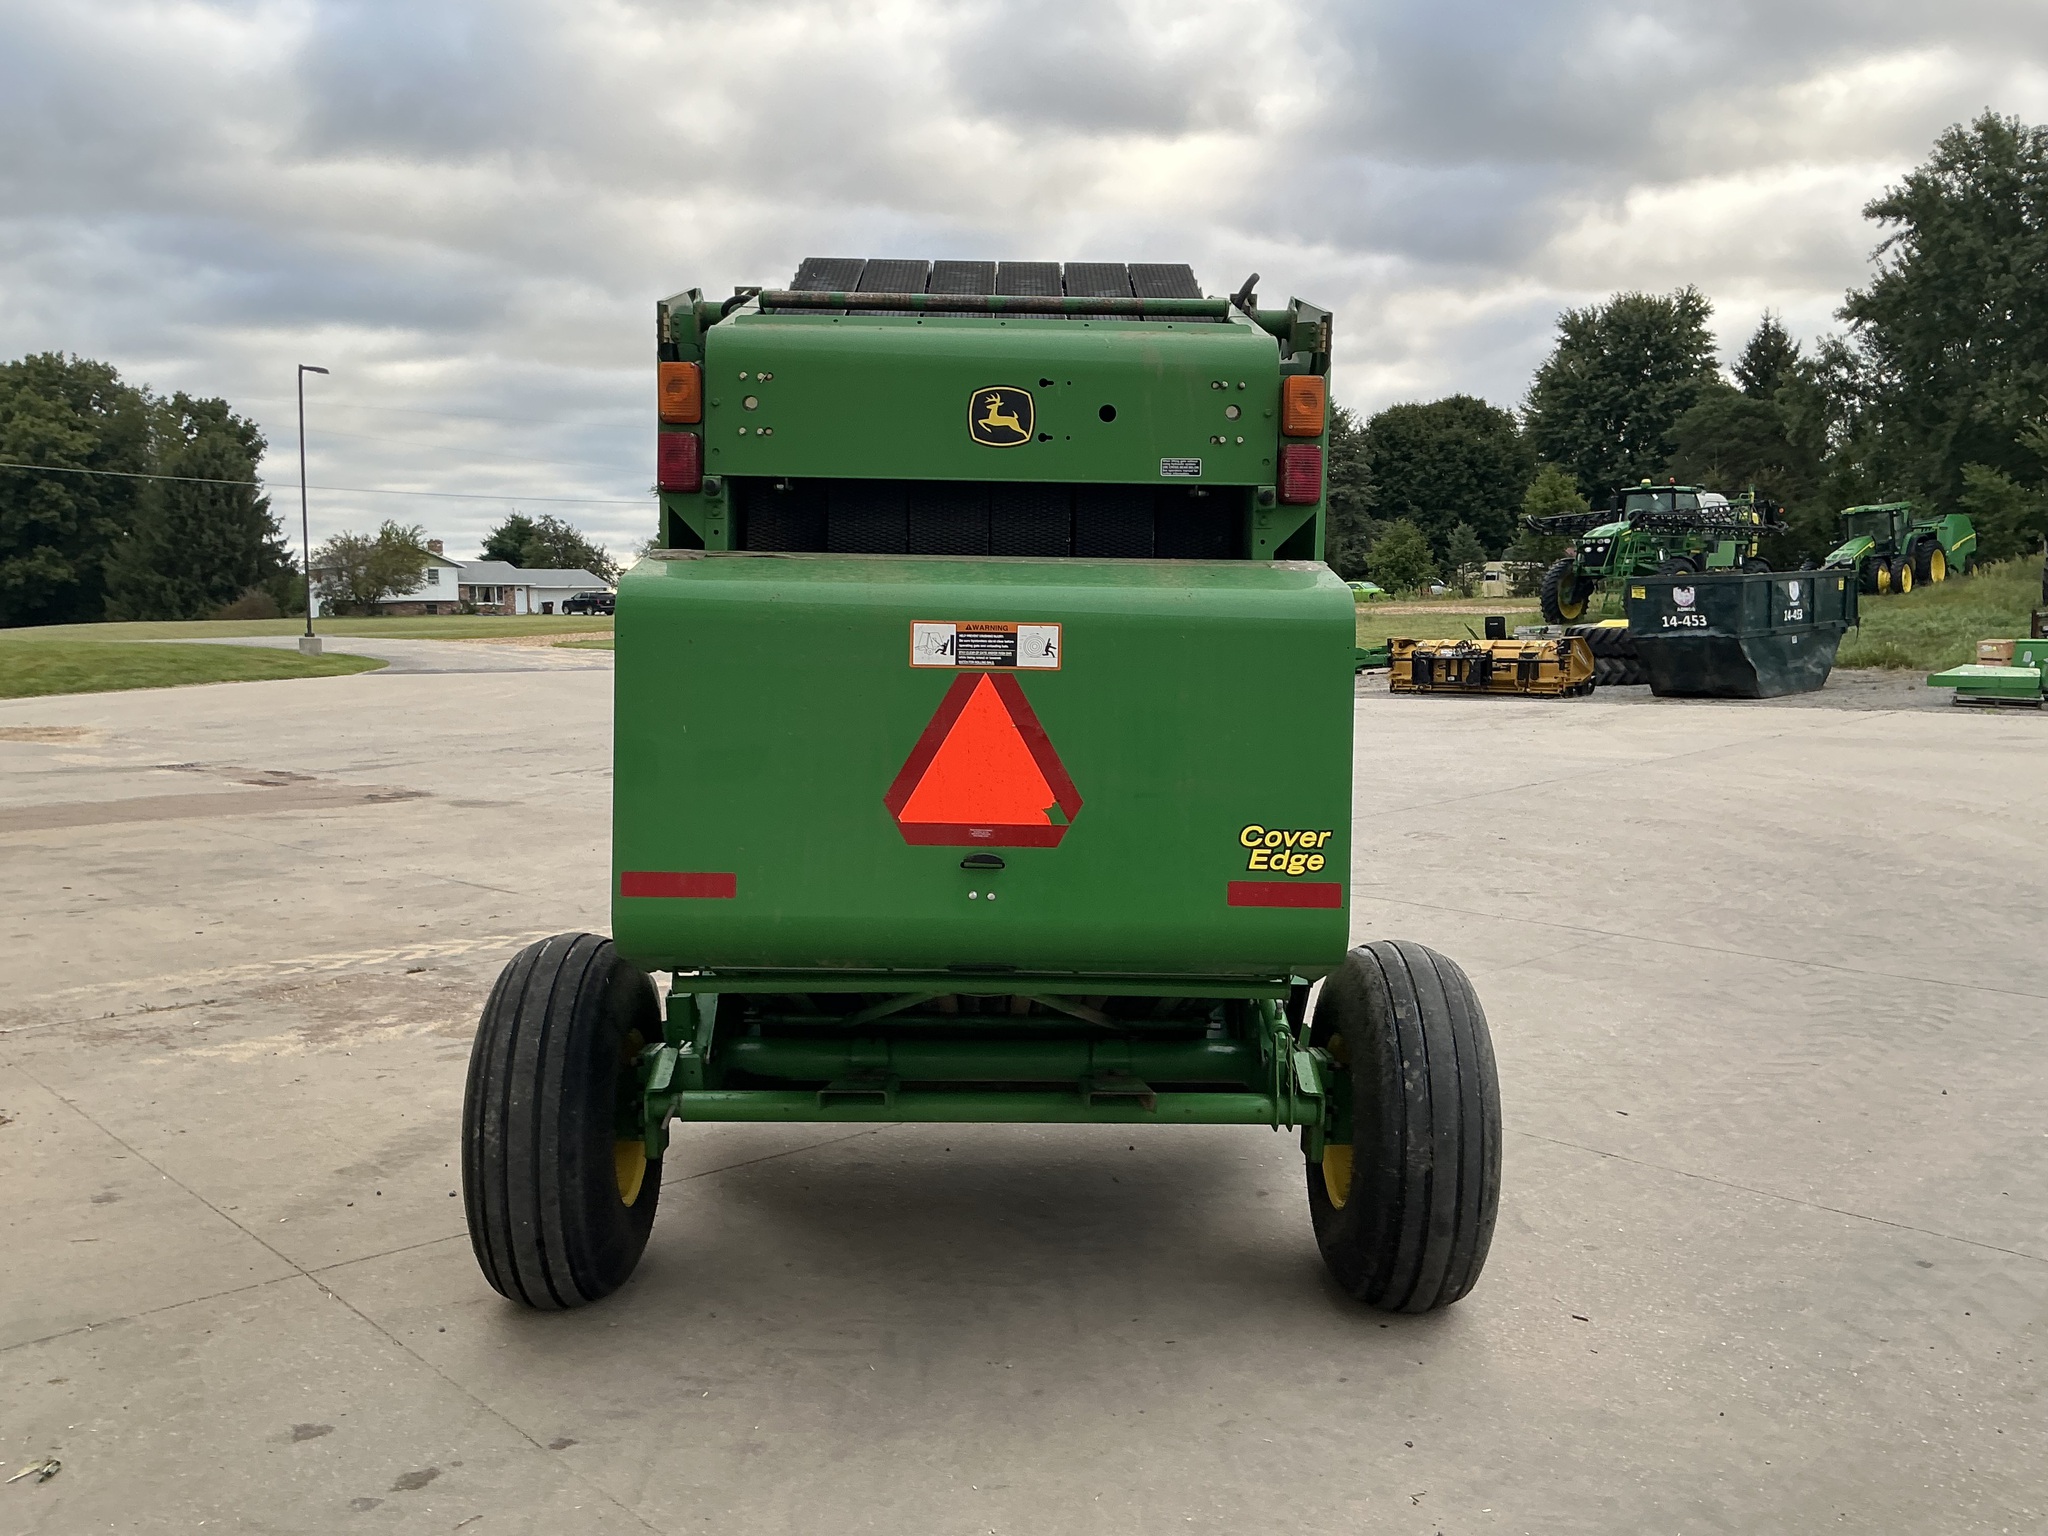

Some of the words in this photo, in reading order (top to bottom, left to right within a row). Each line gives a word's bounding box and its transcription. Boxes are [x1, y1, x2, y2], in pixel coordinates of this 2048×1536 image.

[972, 624, 1009, 632] WARNING
[1661, 614, 1708, 628] 14-453
[1239, 824, 1333, 849] Cover
[1247, 848, 1325, 875] Edge
